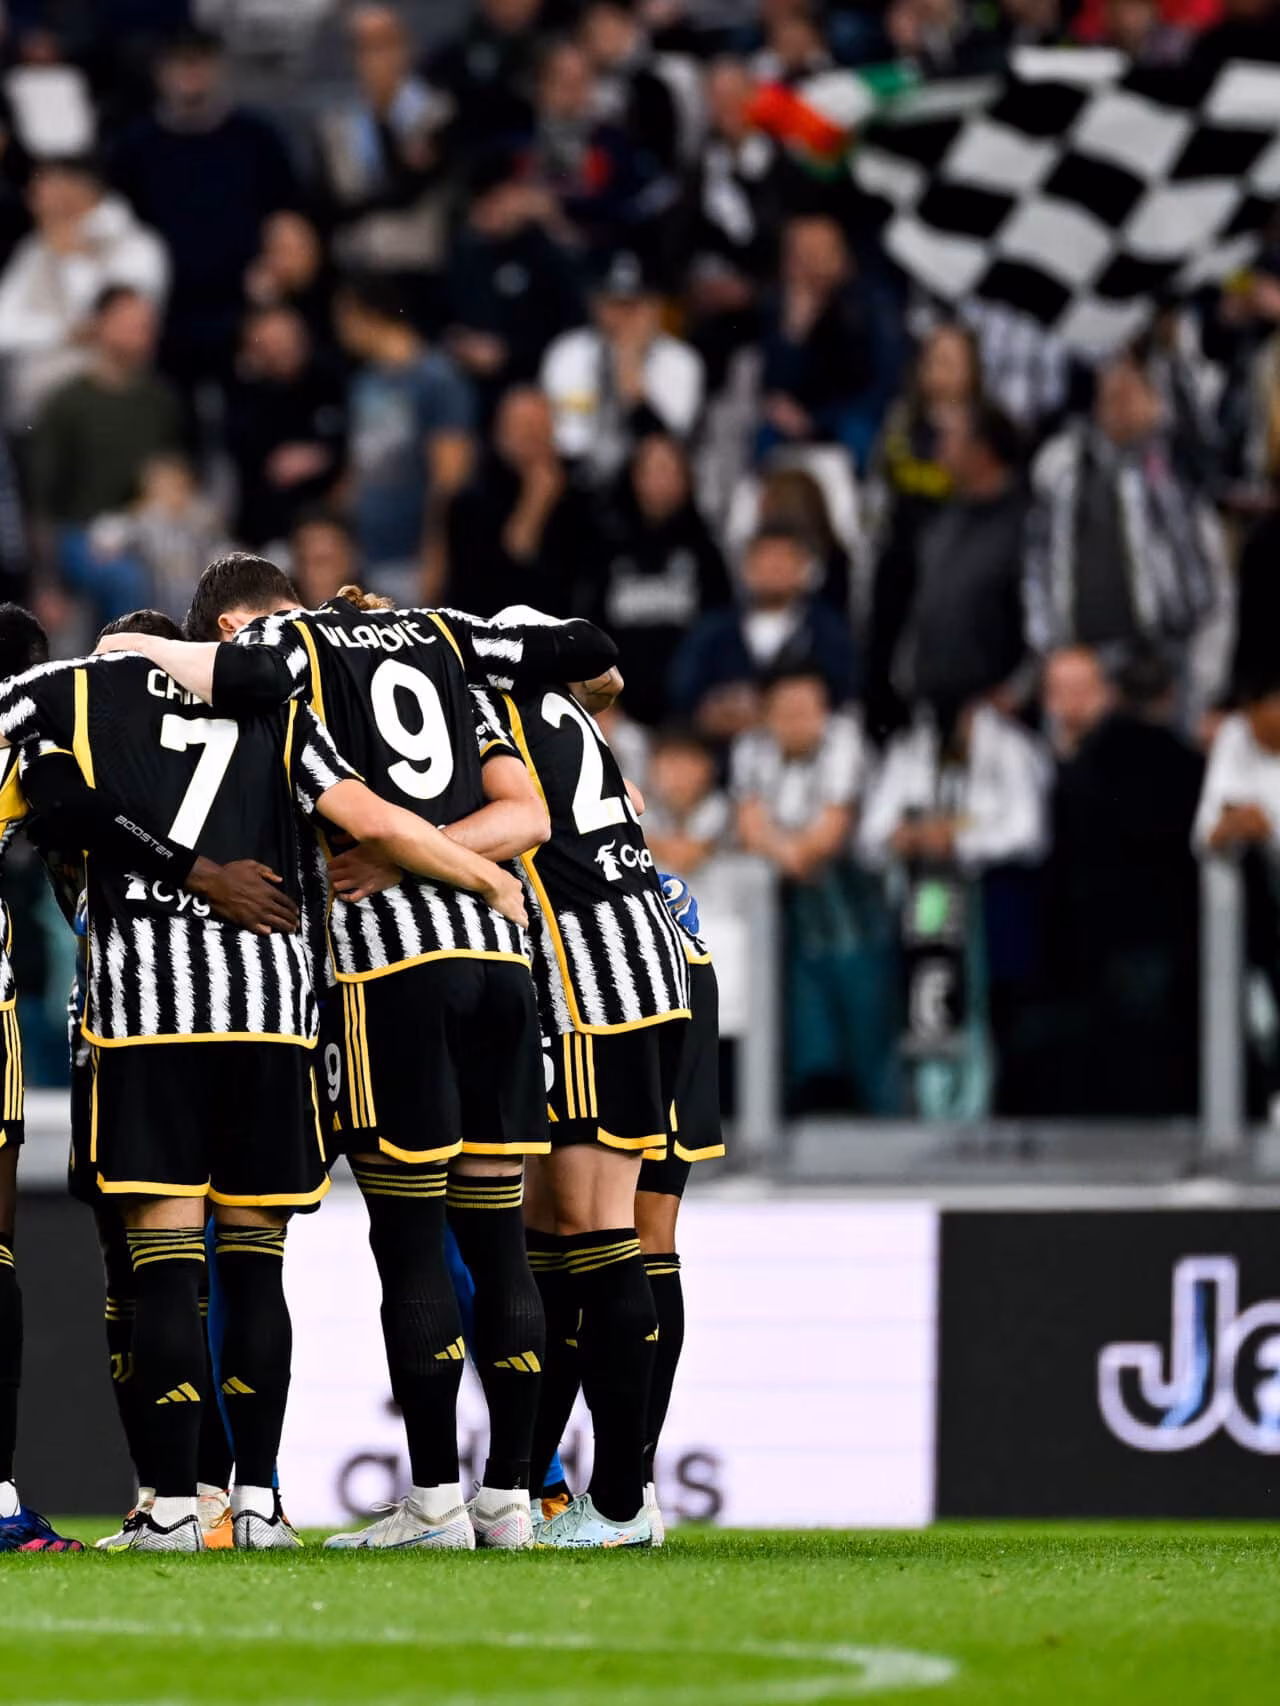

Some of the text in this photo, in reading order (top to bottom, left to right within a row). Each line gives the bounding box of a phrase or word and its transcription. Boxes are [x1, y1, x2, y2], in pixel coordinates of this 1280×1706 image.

[160, 713, 239, 850] 7
[371, 658, 454, 800] 9
[541, 692, 642, 835] 2
[114, 814, 174, 859] BOOSTER
[324, 1043, 342, 1102] 9
